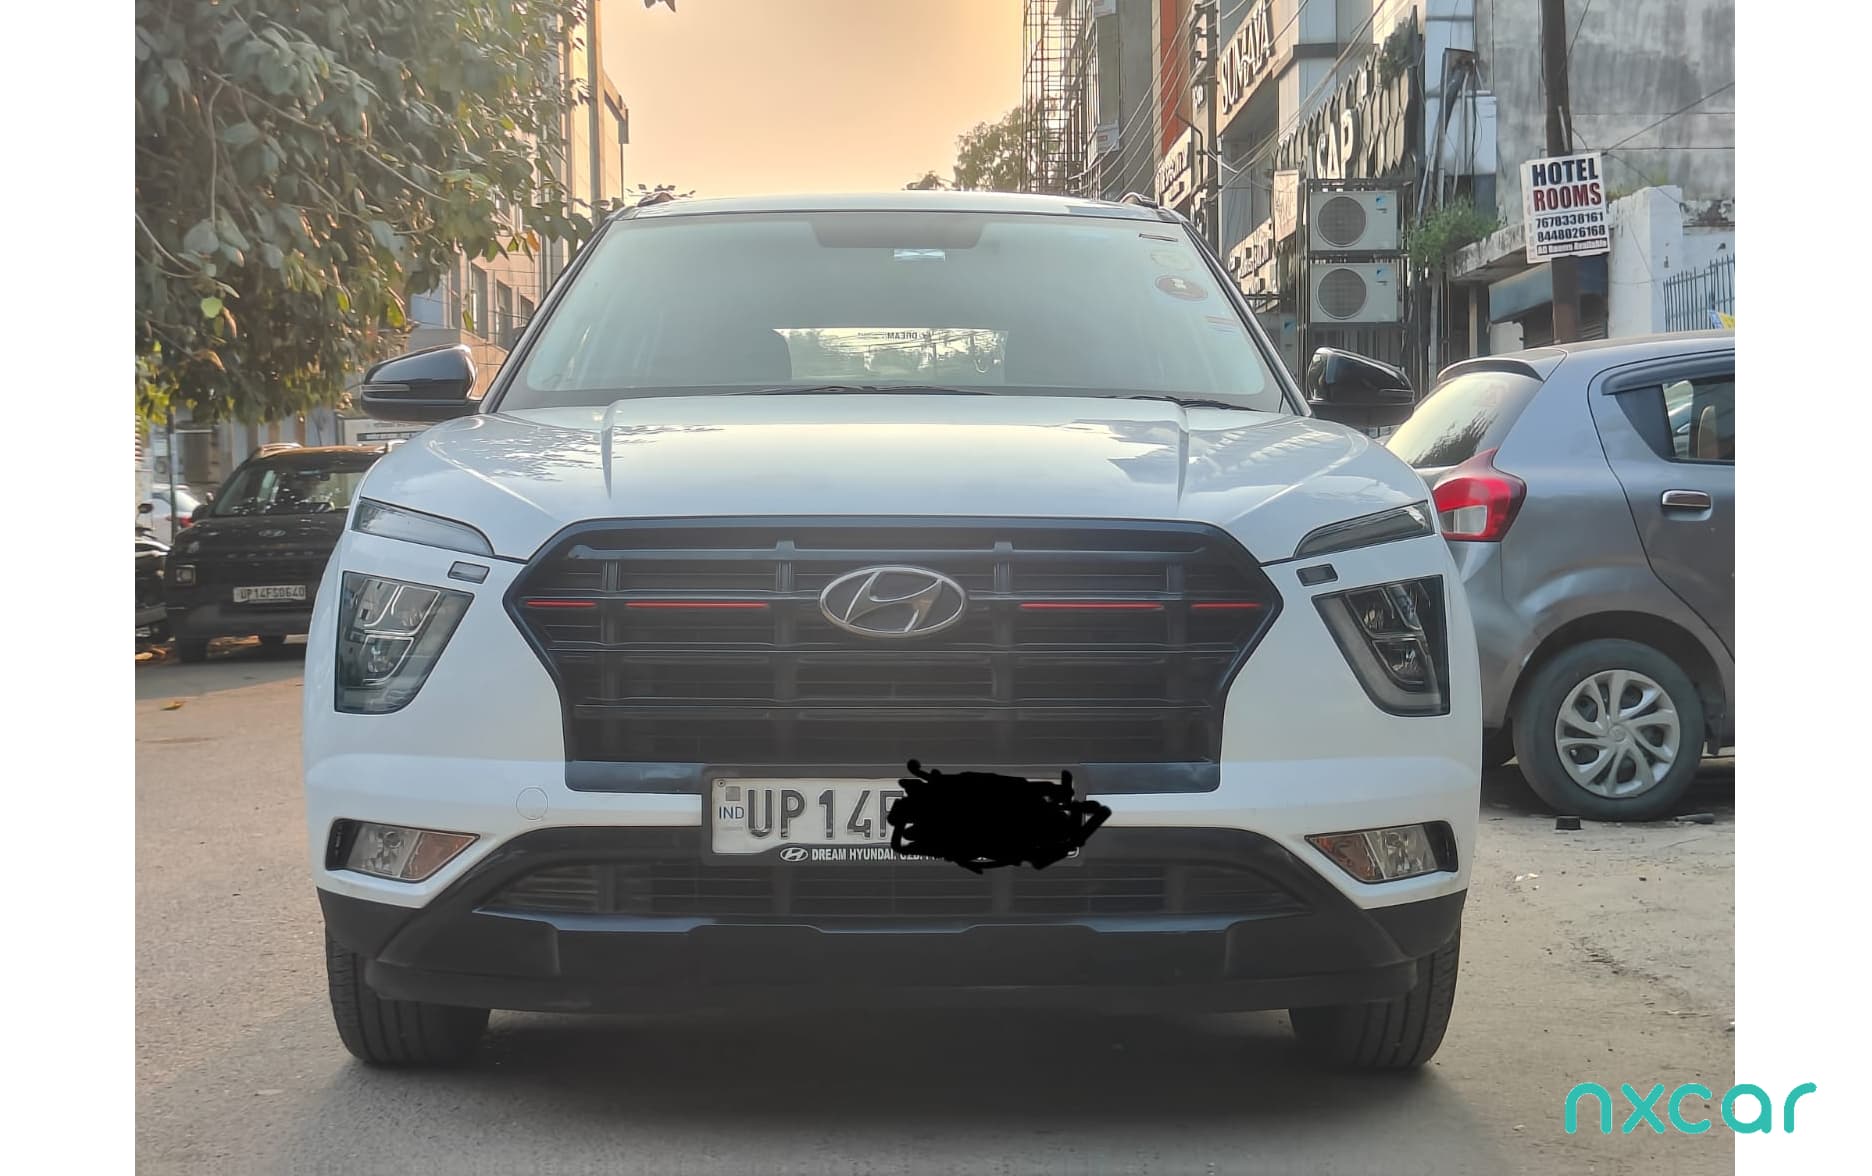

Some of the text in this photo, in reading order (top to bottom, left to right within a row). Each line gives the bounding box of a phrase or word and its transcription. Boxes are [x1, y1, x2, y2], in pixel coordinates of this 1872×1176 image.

[1221, 0, 1271, 114] SUMAYA
[1532, 157, 1599, 187] HOTEL
[1533, 182, 1602, 211] ROOMS
[718, 806, 744, 820] IND
[811, 848, 846, 861] DREAM
